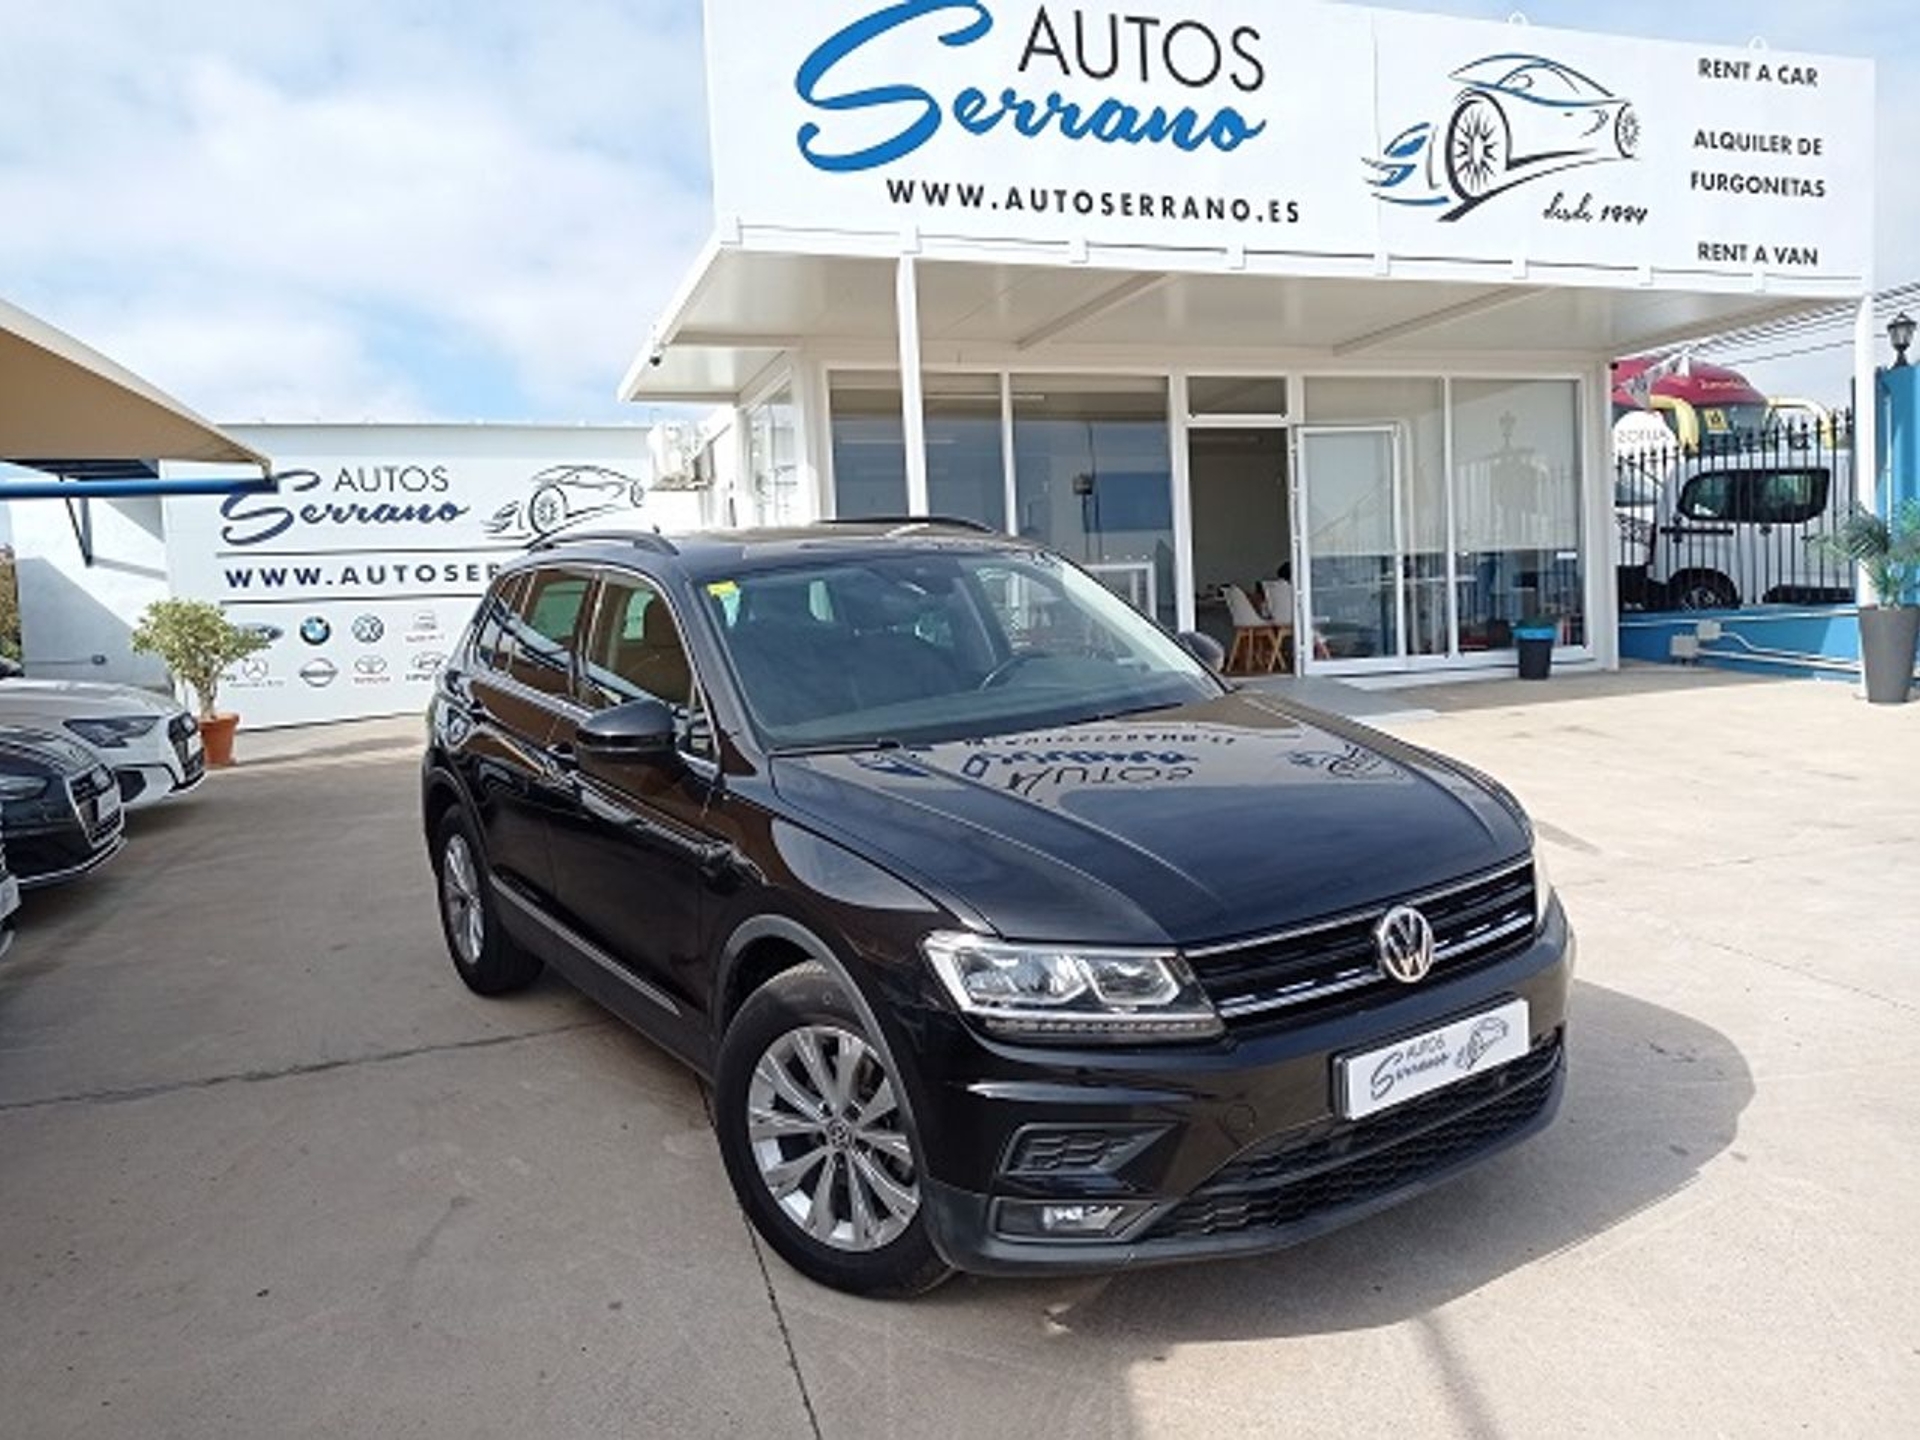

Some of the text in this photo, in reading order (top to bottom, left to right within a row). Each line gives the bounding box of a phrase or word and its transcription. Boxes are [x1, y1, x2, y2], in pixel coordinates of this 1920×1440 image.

[1018, 5, 1266, 92] AUTOS
[795, 0, 1268, 173] Serrano
[1698, 58, 1819, 88] RENT A CAR
[1694, 130, 1823, 157] ALQUILER DE
[1691, 172, 1827, 198] FURGONETAS
[887, 180, 1300, 224] WWW.AUTOSERRANO.ES
[1698, 243, 1819, 267] RENT A VAN
[334, 466, 450, 493] AUTOS
[220, 469, 470, 546] Serrano
